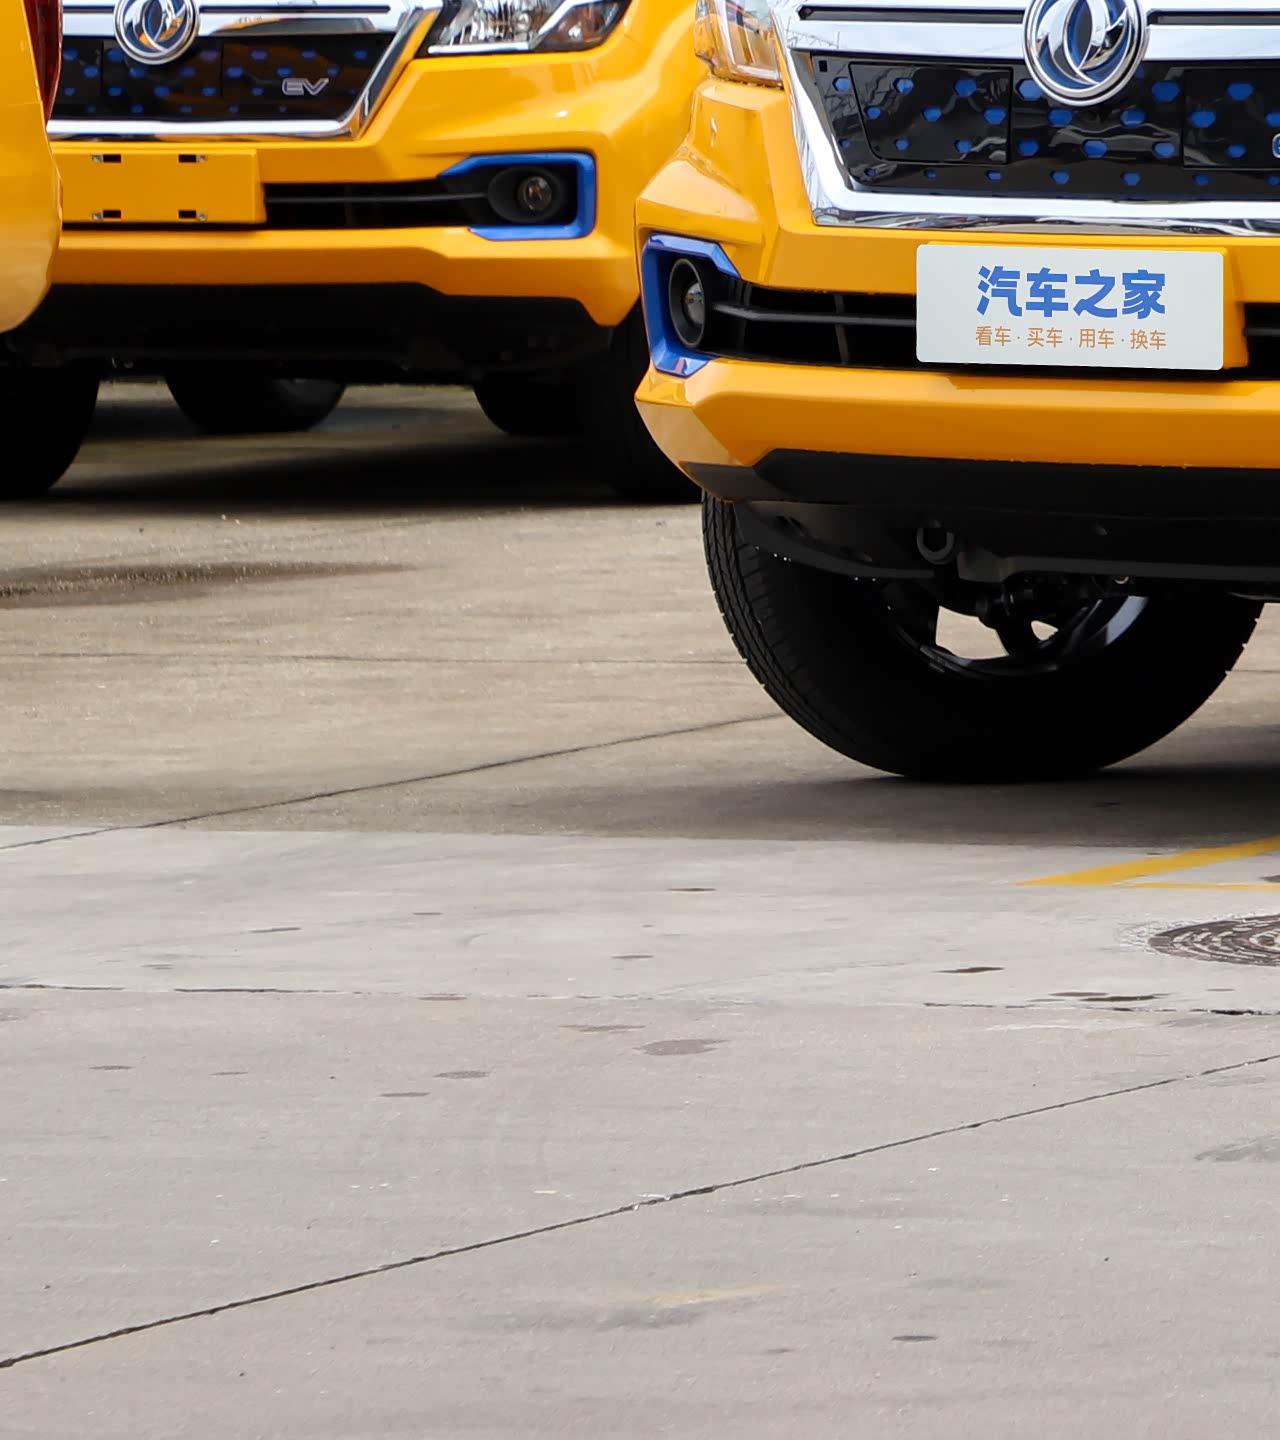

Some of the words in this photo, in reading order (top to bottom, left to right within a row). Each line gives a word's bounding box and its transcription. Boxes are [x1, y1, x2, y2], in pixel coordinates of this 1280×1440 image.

[281, 77, 329, 96] EV
[976, 265, 1167, 320] 汽车之家
